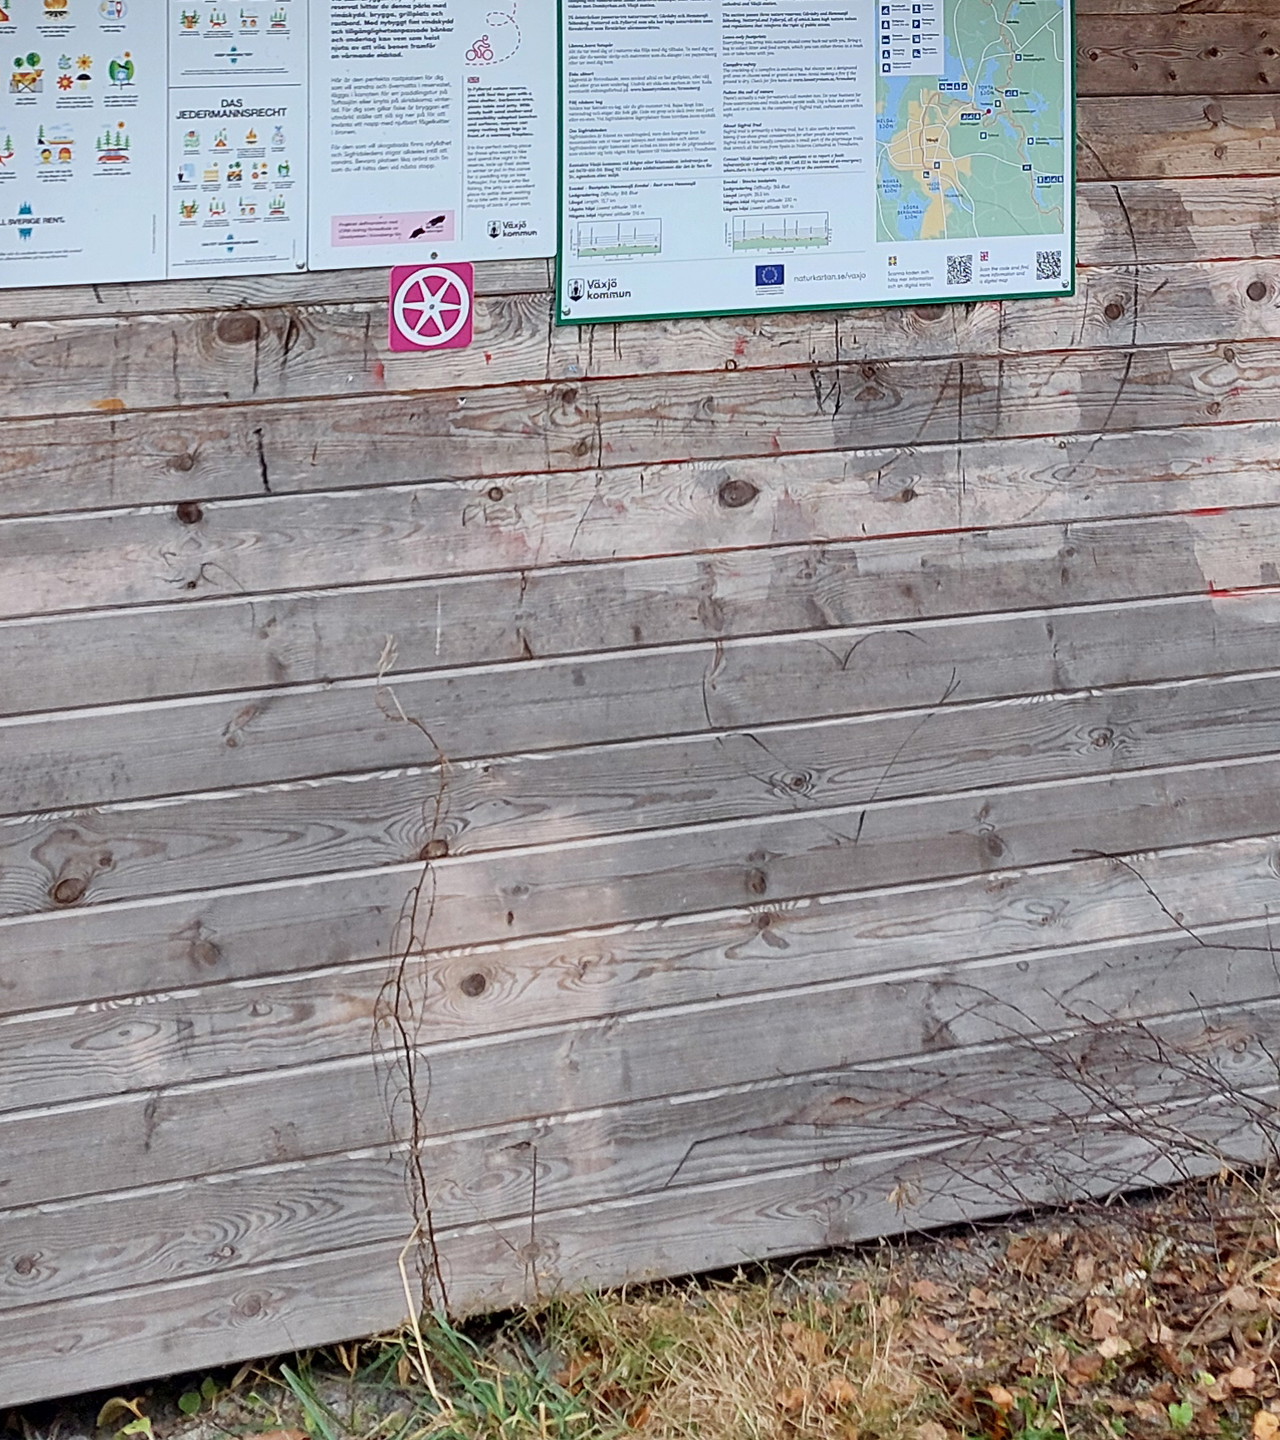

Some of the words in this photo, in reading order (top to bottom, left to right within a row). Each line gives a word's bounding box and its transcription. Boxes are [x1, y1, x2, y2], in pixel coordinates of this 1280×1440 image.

[221, 99, 243, 107] DAS
[176, 108, 287, 119] JEDERMANNSRECHT
[587, 279, 617, 291] Växjö
[587, 290, 631, 299] kommun
